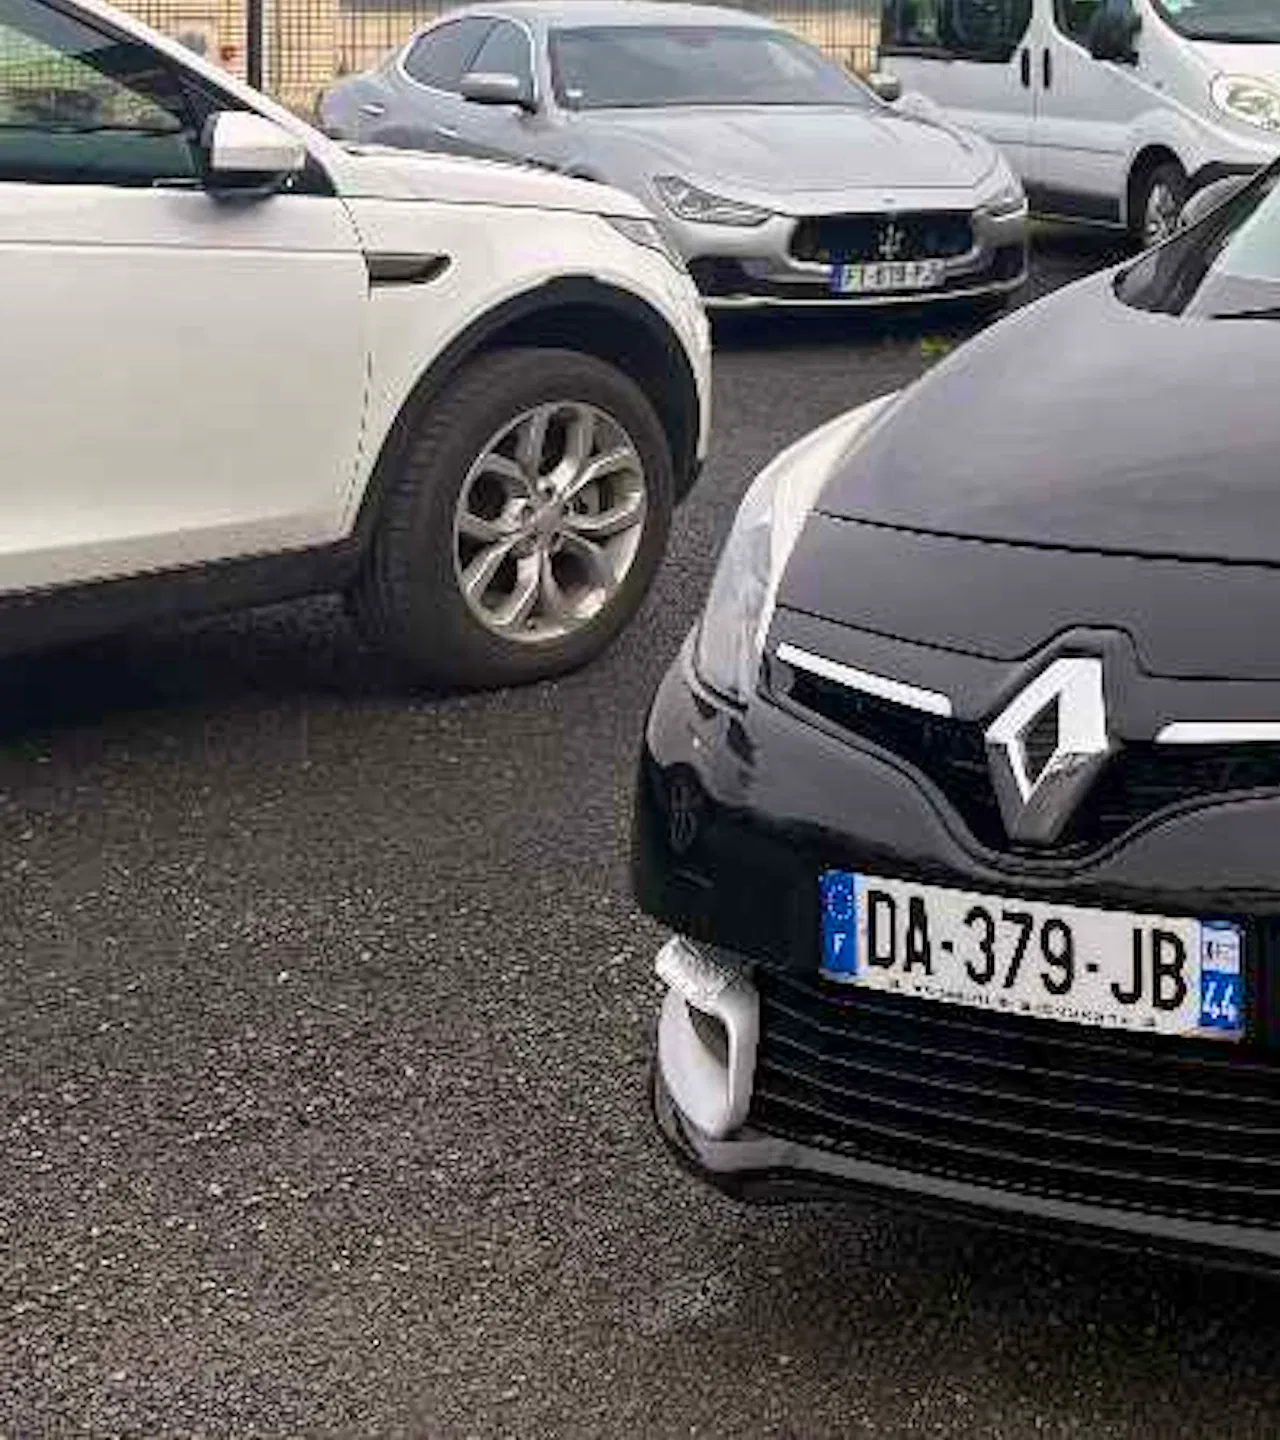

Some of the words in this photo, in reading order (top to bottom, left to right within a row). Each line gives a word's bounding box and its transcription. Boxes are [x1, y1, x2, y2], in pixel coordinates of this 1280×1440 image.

[831, 932, 846, 953] F
[867, 890, 1188, 1011] DA-379-JB
[1202, 980, 1237, 1023] 44
